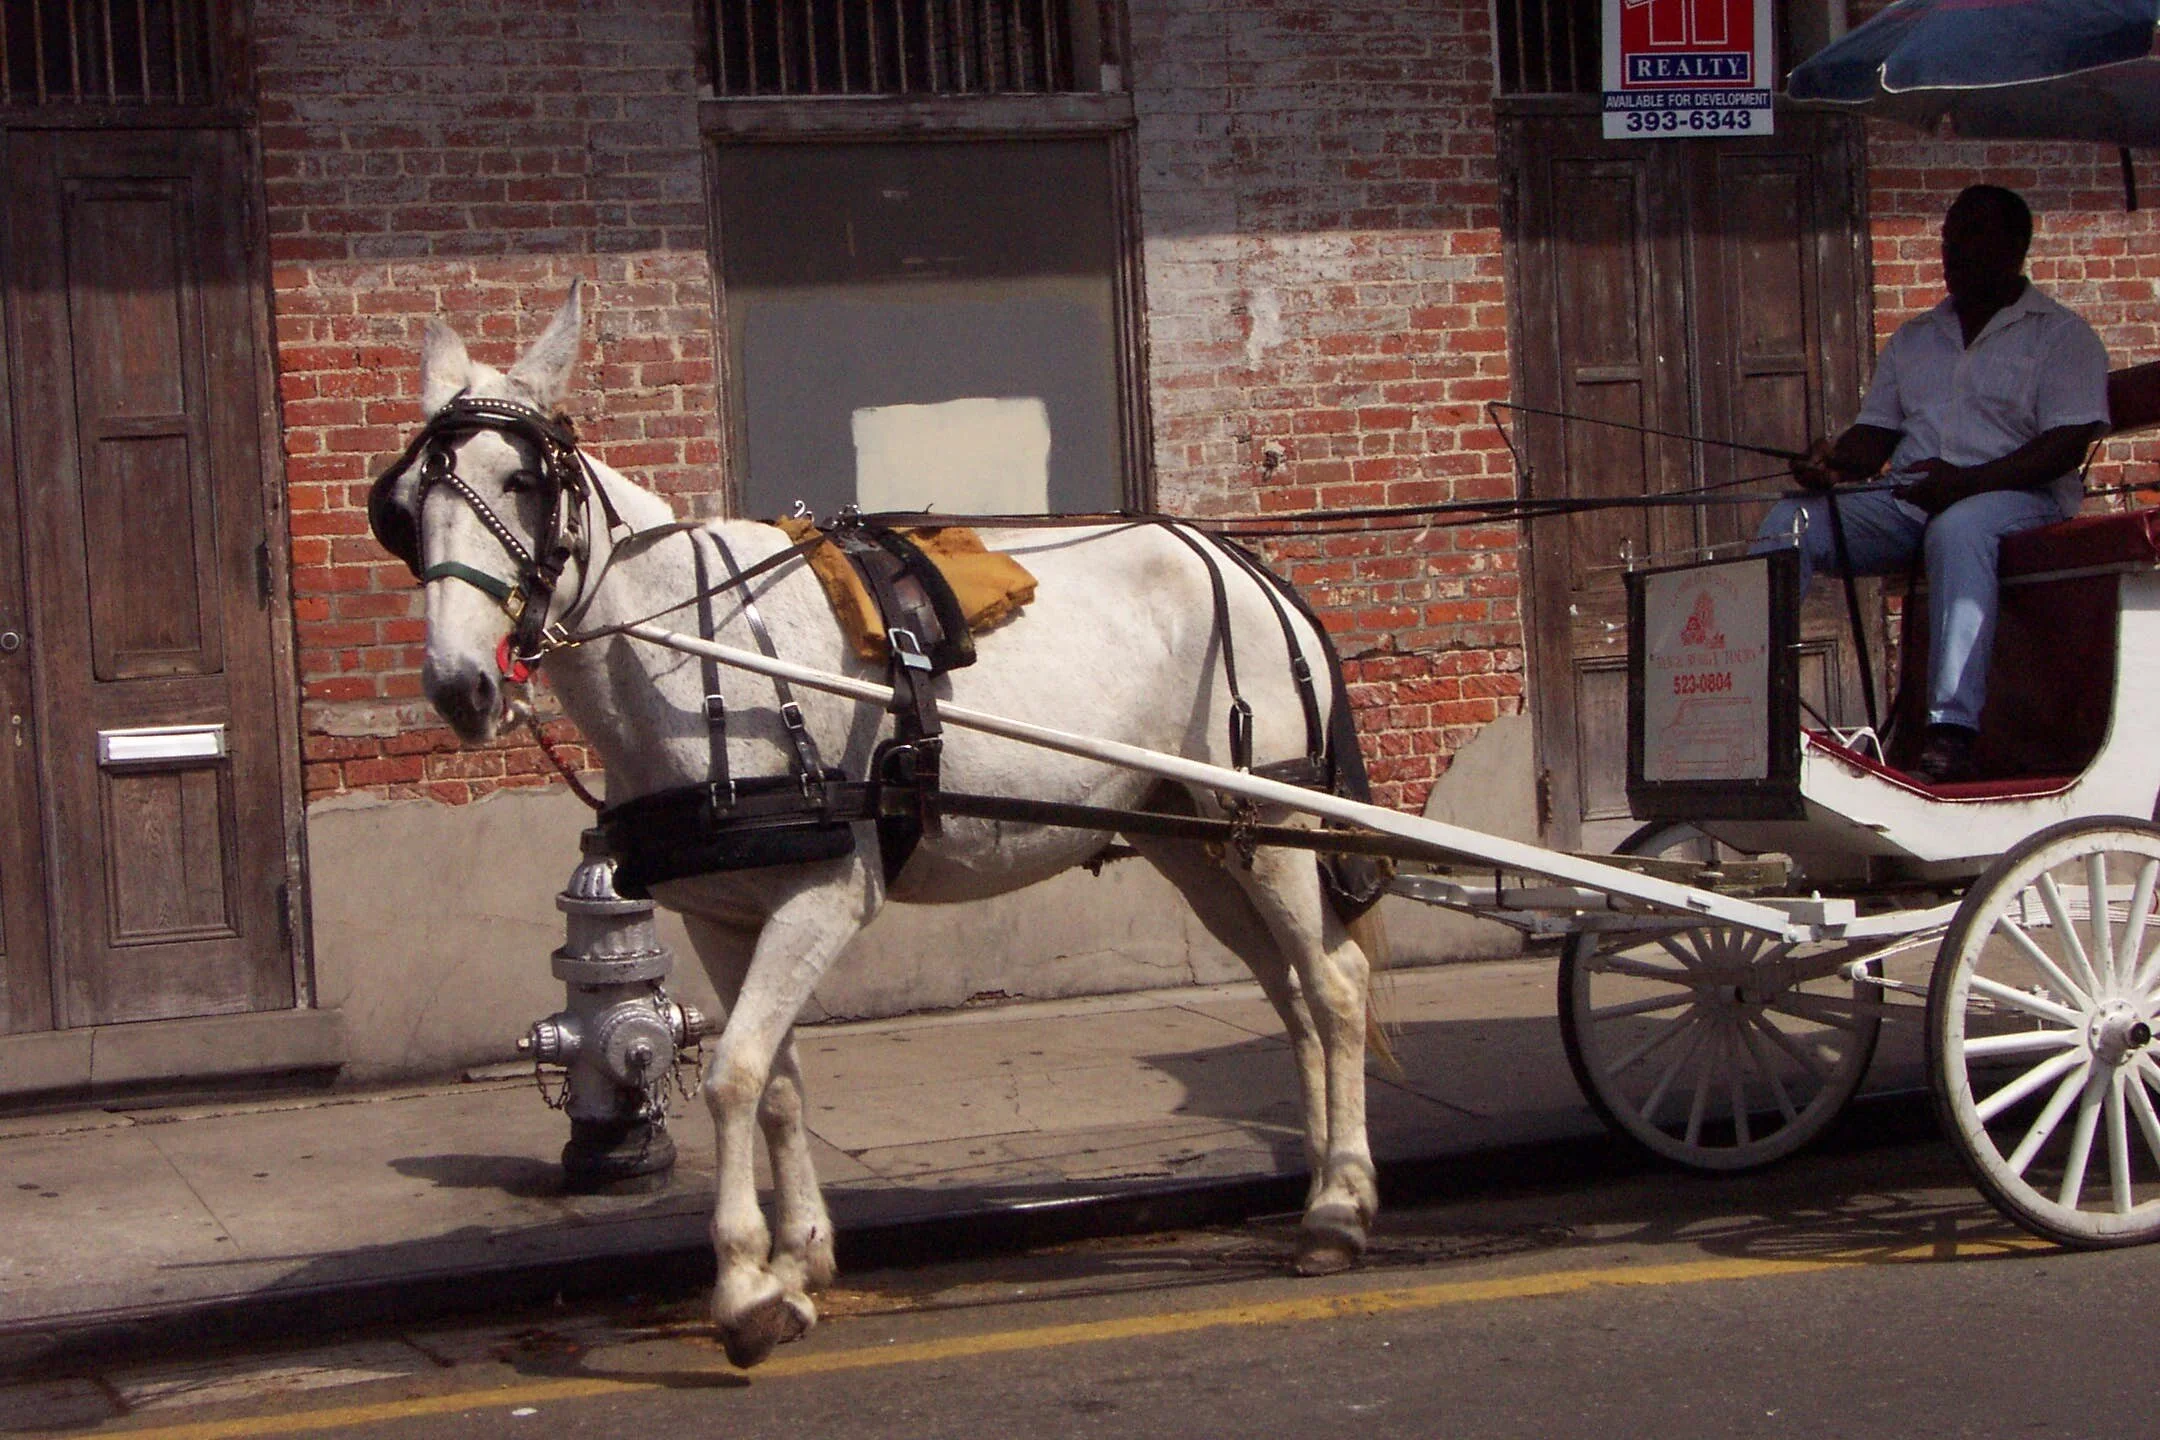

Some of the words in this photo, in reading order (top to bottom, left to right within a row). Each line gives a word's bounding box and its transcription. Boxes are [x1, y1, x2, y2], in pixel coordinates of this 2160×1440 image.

[1637, 57, 1741, 77] REALTY
[1606, 93, 1664, 108] AVAILABLE
[1668, 93, 1691, 107] FOR
[1694, 92, 1768, 106] DEVELOPMENT
[1626, 110, 1751, 132] 393-6343
[1673, 672, 1732, 695] 523-0804
